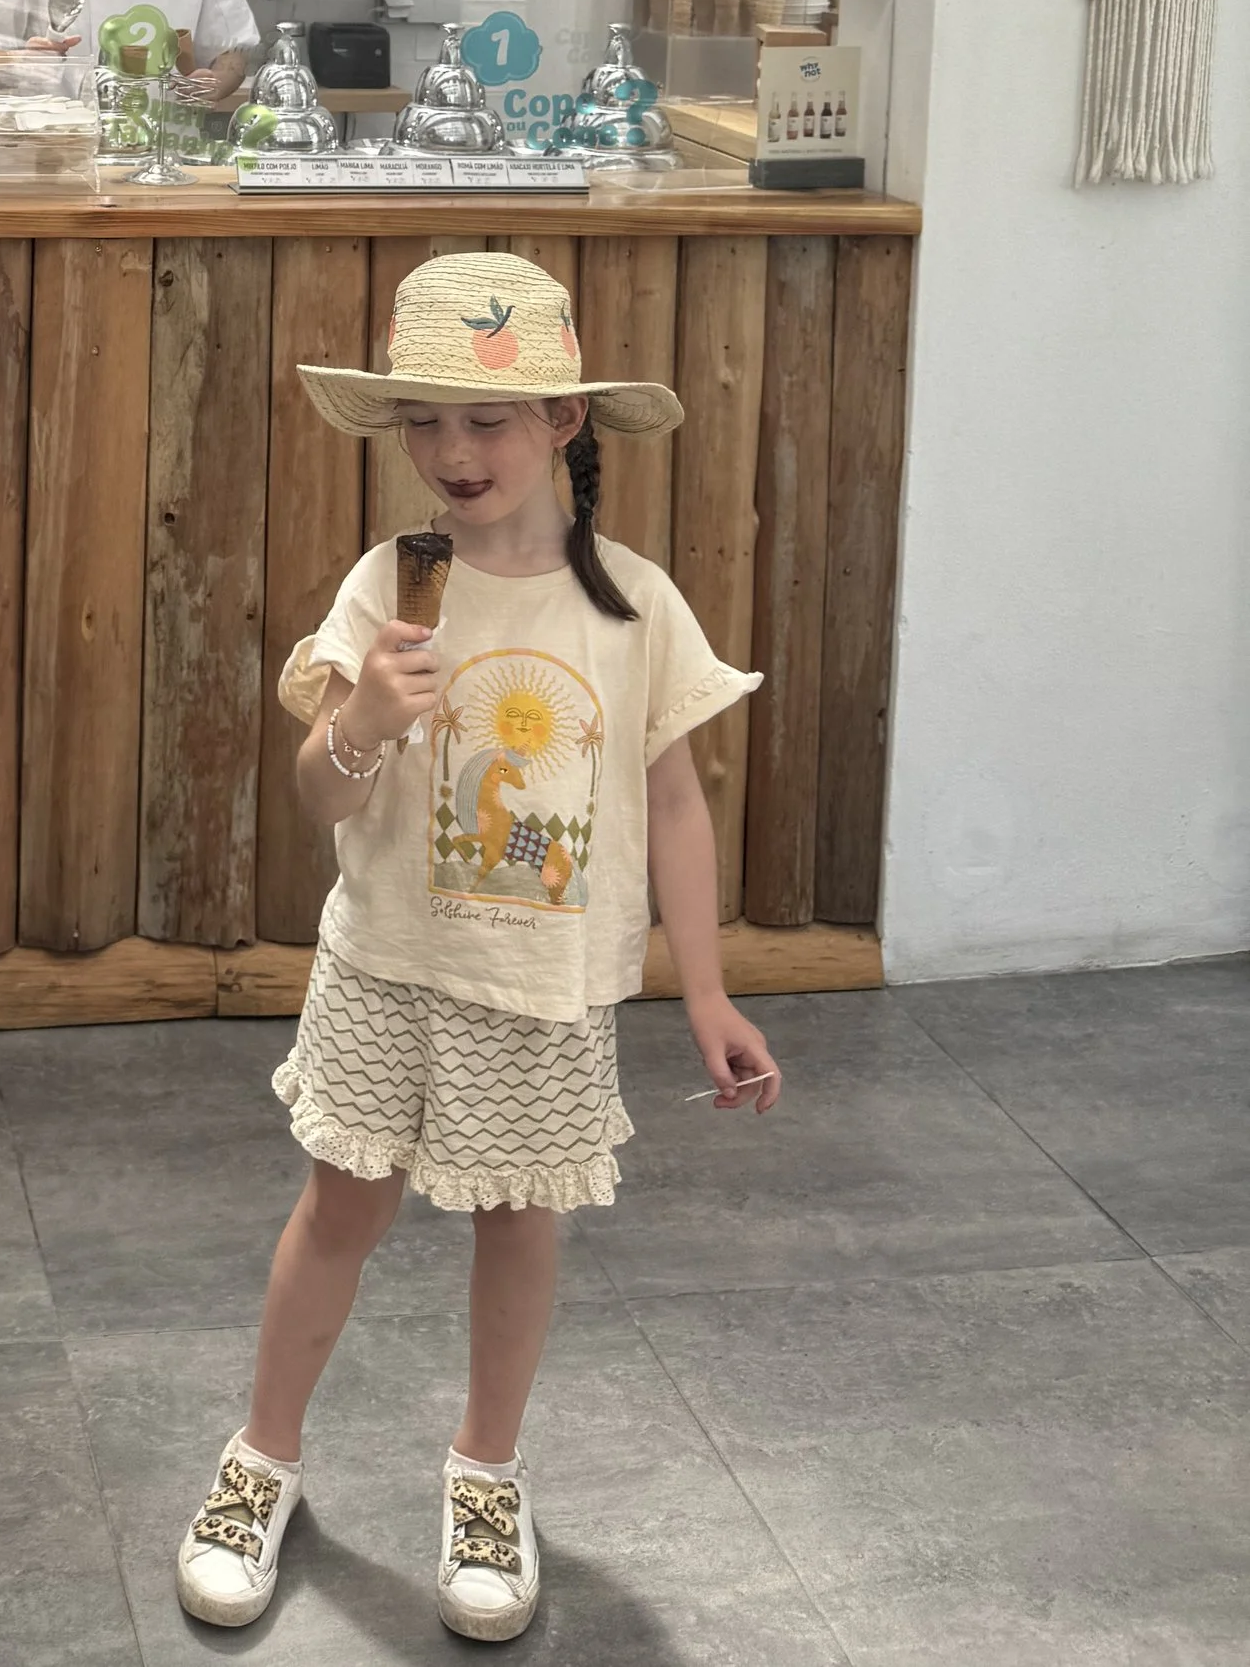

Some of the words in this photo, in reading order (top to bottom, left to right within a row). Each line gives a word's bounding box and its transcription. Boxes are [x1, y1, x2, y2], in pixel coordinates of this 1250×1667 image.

[491, 29, 509, 66] 1
[800, 63, 818, 71] why
[805, 68, 821, 77] not
[504, 89, 596, 126] Copo
[507, 121, 526, 132] ou
[485, 907, 536, 929] Forever
